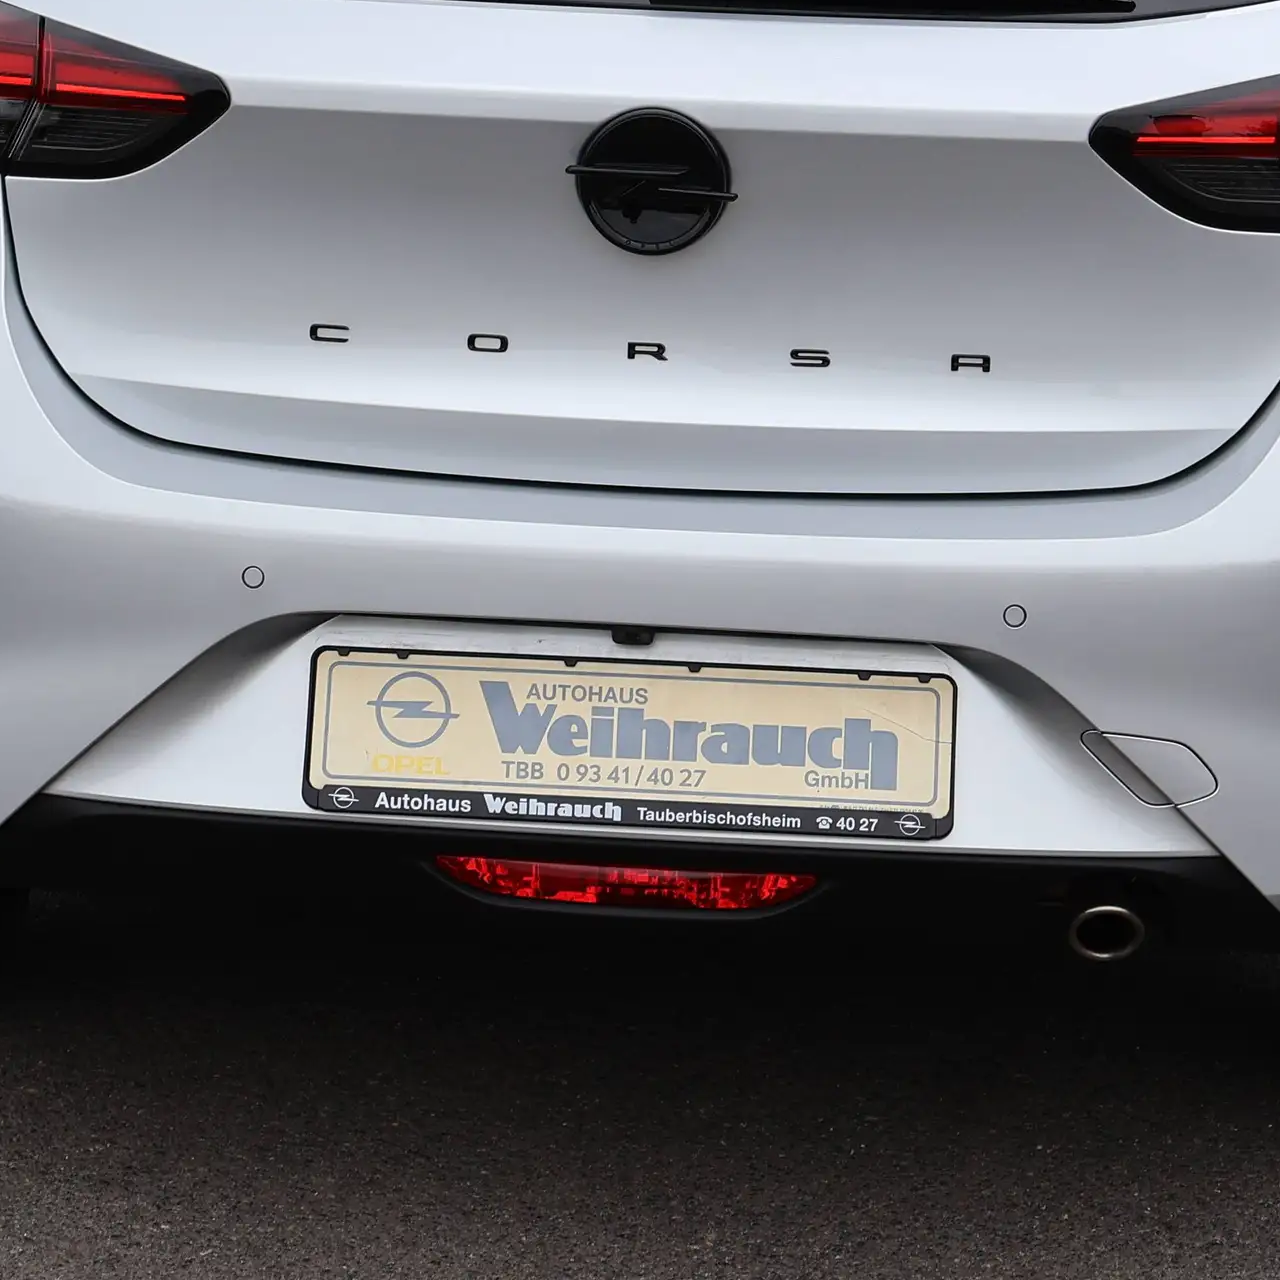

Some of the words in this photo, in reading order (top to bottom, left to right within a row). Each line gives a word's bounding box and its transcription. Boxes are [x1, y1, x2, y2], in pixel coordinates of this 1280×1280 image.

[526, 683, 649, 705] AUTOHAUS
[479, 680, 898, 791] Weihrauch
[372, 754, 451, 775] OPEL
[501, 760, 544, 780] TBB
[804, 770, 869, 790] GmbH
[374, 791, 472, 813] Autohaus
[483, 793, 622, 821] Weihrauch
[636, 806, 801, 829] Tauberbischofsheim
[835, 816, 855, 831] 40
[859, 818, 878, 832] 27
